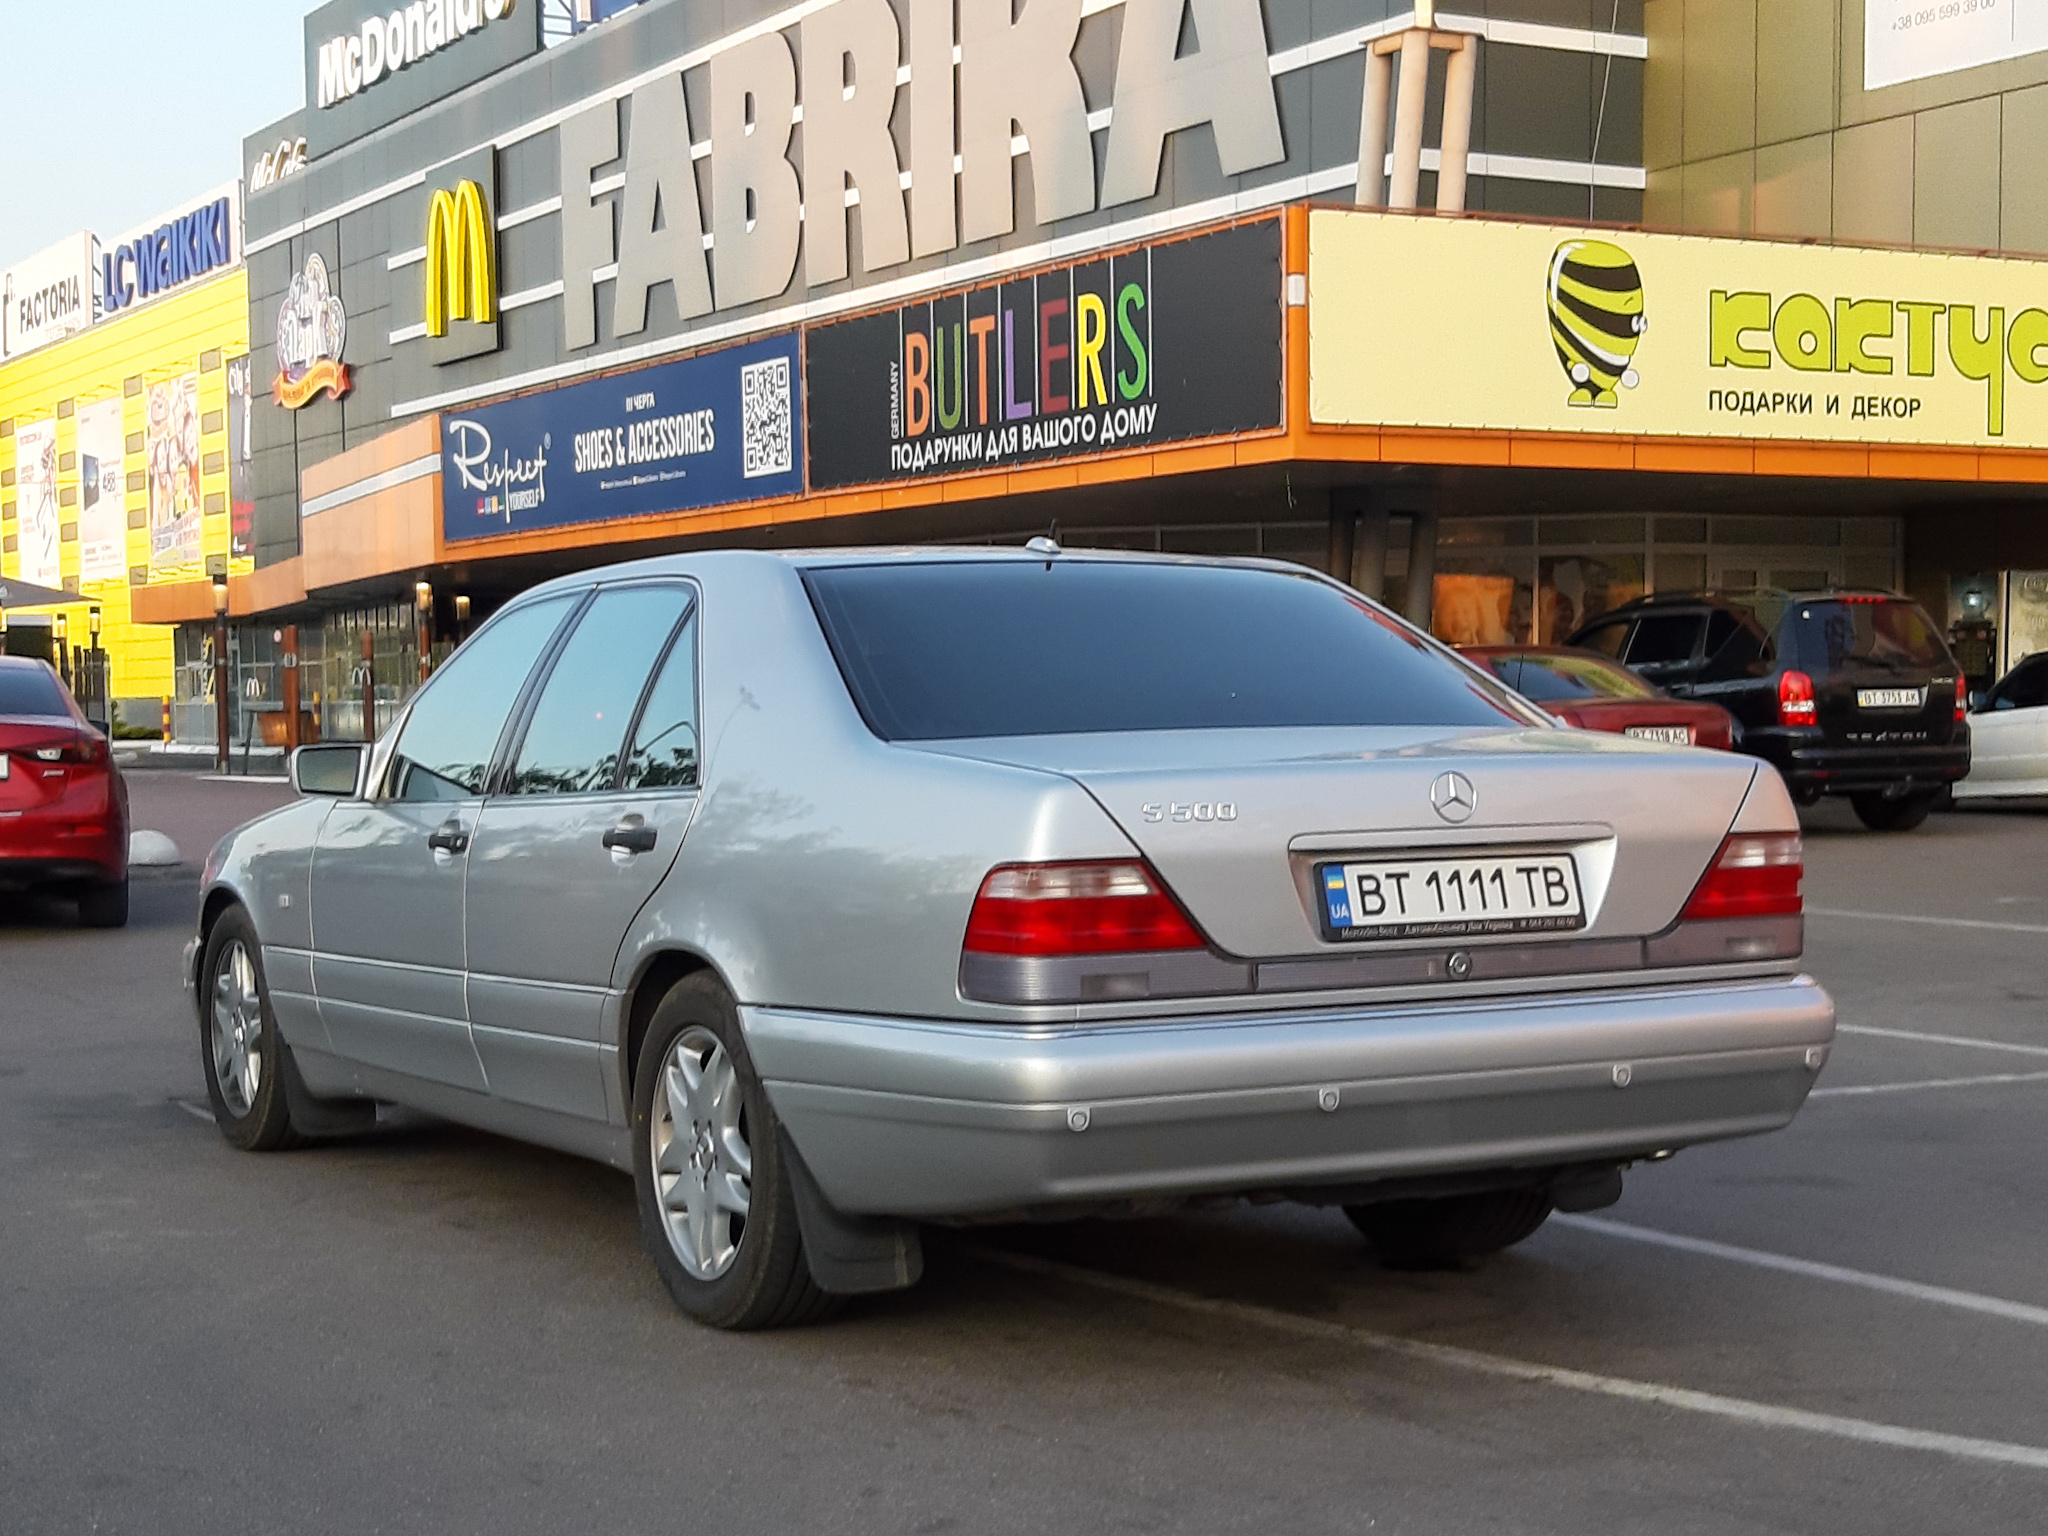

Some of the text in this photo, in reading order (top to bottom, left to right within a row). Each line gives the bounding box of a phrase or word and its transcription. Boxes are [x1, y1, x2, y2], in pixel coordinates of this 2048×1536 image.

[1914, 8, 1936, 26] 095
[1939, 2, 1960, 20] 599
[1963, 0, 1978, 14] 39
[560, 0, 1286, 351] FABRIKA
[20, 274, 81, 335] FACTORIA
[103, 244, 135, 313] LC
[904, 283, 1147, 438] BUTLERS
[633, 391, 656, 411] ЧЕРГА
[890, 361, 899, 440] GERMANY
[1708, 390, 1922, 421] ПОДАРКИ И ДЕКОР
[574, 407, 716, 474] SHOES & ACCESSORIES
[891, 402, 1158, 473] ПОДАРУНКИ ДЛЯ ВАШОГО ДОМУ
[449, 419, 548, 524] Respect
[508, 487, 541, 512] YOURSELF
[1142, 801, 1238, 824] S 500
[1331, 903, 1350, 919] UA
[1356, 865, 1570, 918] BT 1111 TB
